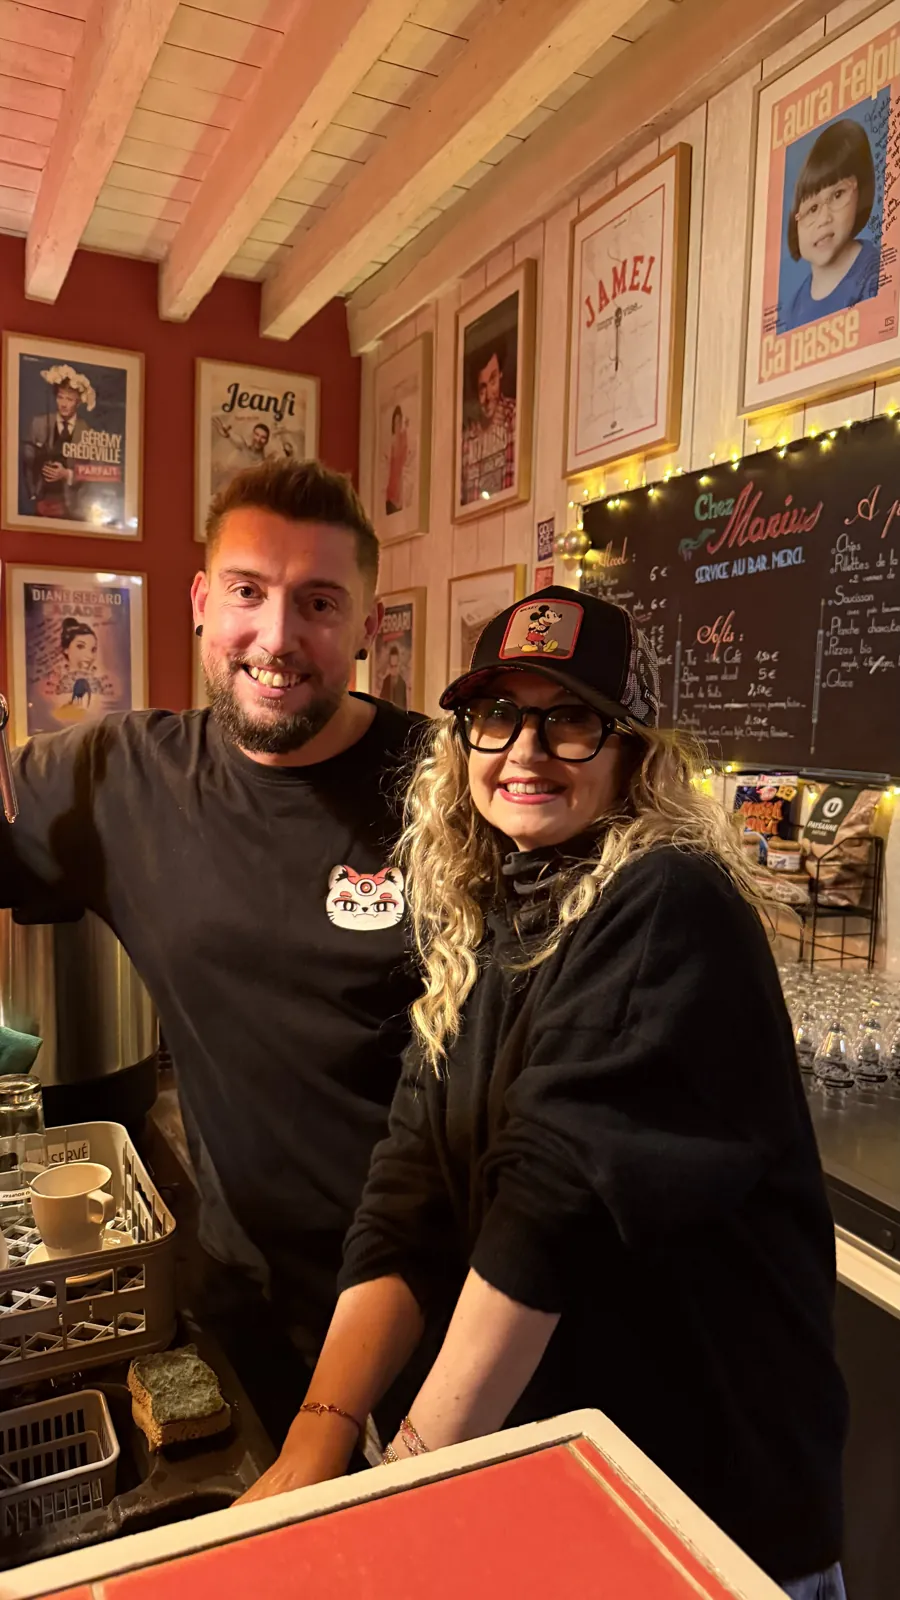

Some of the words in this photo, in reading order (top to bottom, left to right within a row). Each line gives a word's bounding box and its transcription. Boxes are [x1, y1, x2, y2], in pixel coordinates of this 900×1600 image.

[771, 81, 833, 151] Laura
[585, 254, 655, 328] JAMEL
[761, 335, 786, 380] Ça
[790, 309, 859, 372] passe
[222, 382, 296, 422] Jeanfi
[81, 428, 122, 449] GÉRÉMY
[62, 441, 121, 464] CRÉDEVILLE
[79, 465, 118, 476] PARFAIT
[695, 492, 735, 521] Chez
[707, 481, 824, 555] Marius
[836, 533, 861, 557] Chips
[695, 561, 729, 584] SERVICE
[731, 557, 746, 577] AU
[747, 554, 770, 574] BAR.
[32, 588, 71, 603] DIANE
[833, 584, 875, 606] Saucisson
[830, 616, 860, 636] Planche
[828, 635, 854, 655] Pizzas
[860, 638, 872, 654] bio
[806, 821, 838, 832] PAYSANNE
[45, 1142, 88, 1164] SERVÉ
